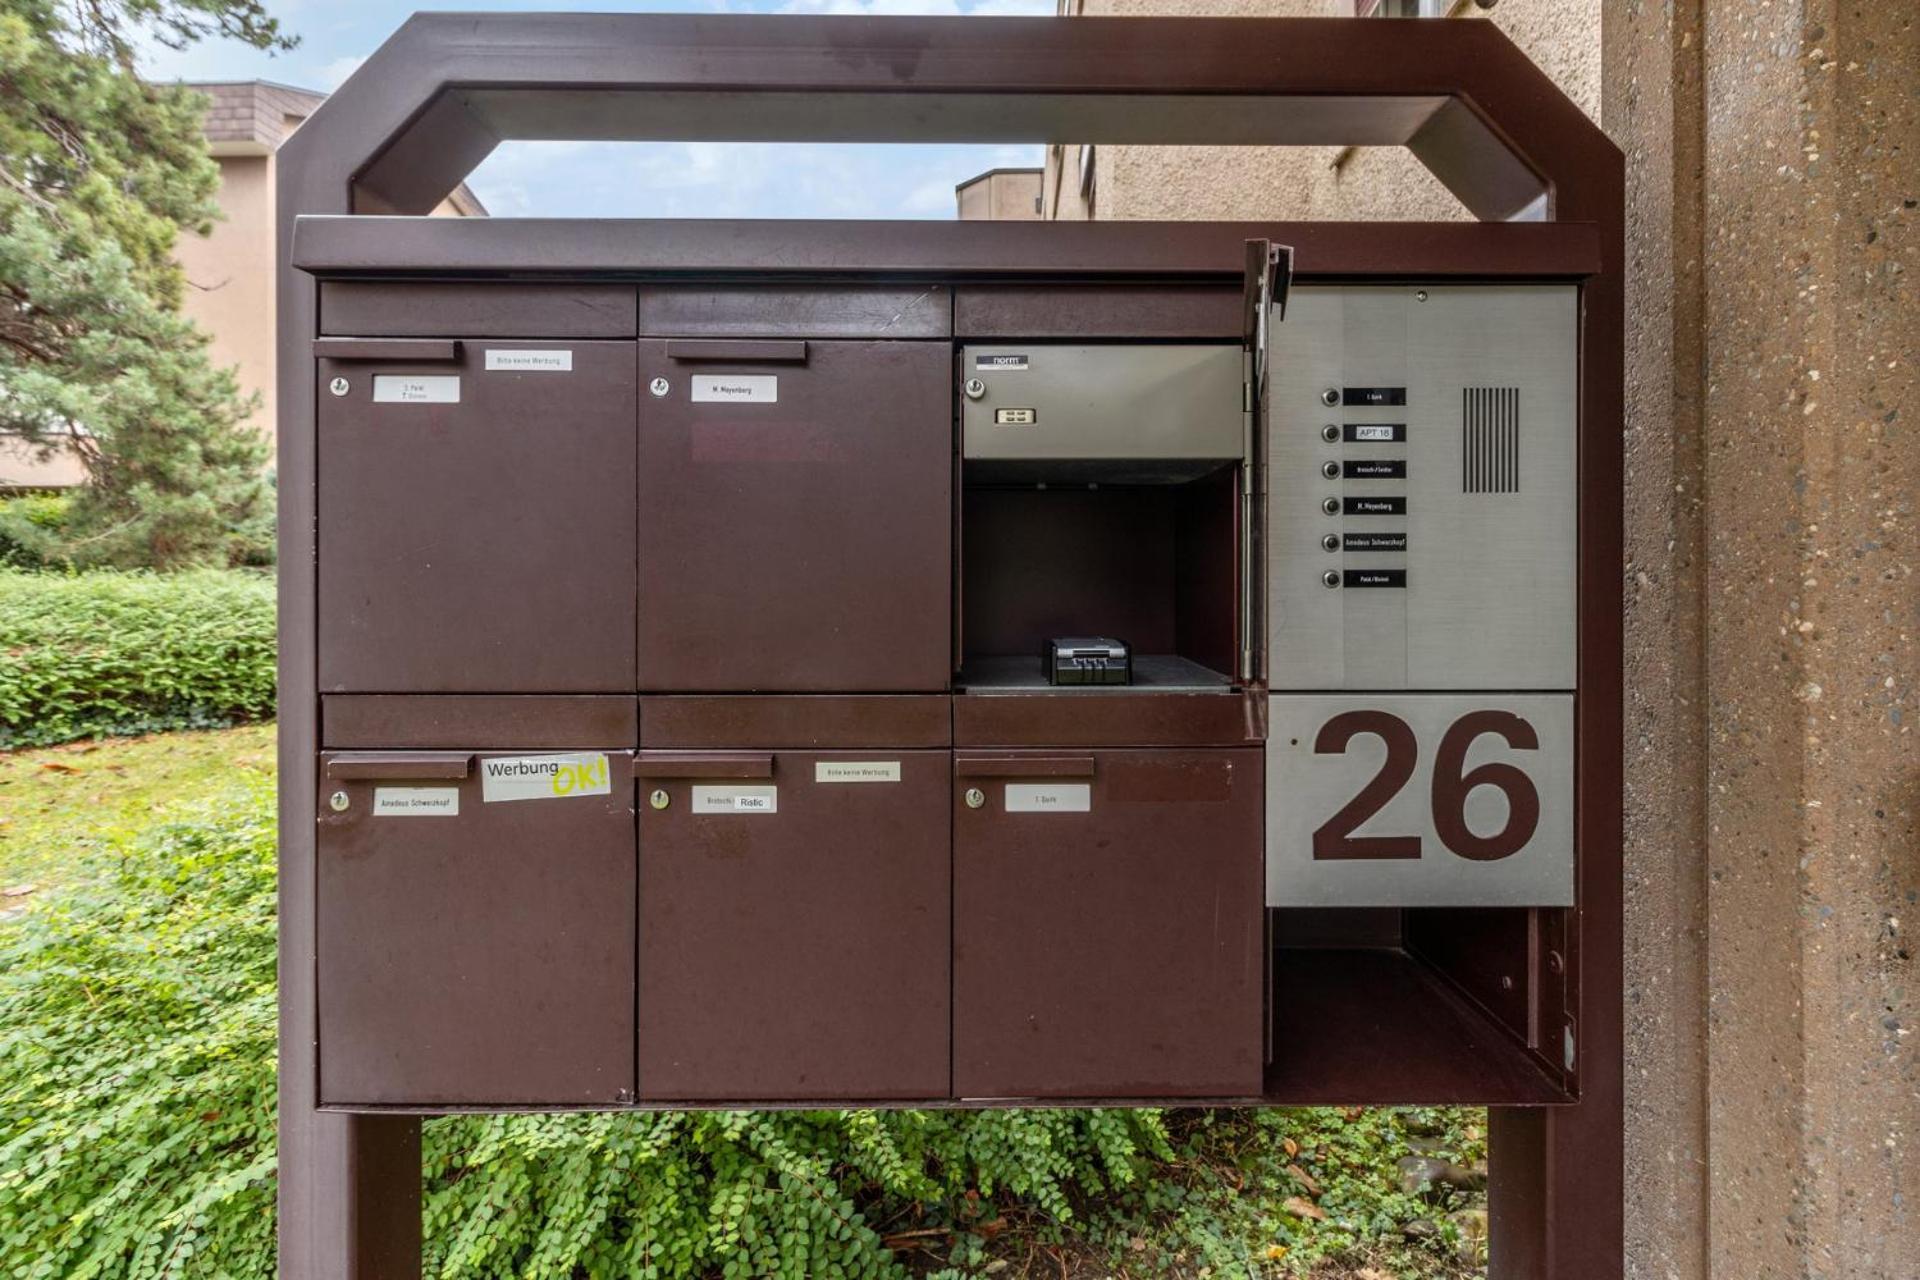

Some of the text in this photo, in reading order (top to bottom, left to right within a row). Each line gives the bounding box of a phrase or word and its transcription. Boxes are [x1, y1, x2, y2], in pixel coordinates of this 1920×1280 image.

[531, 357, 561, 366] Werbung
[1359, 429, 1390, 437] APT 18
[488, 761, 559, 776] Werbung
[862, 768, 890, 777] Werbung
[553, 755, 606, 796] OK!
[1312, 710, 1540, 862] 26
[740, 798, 764, 807] Ristic
